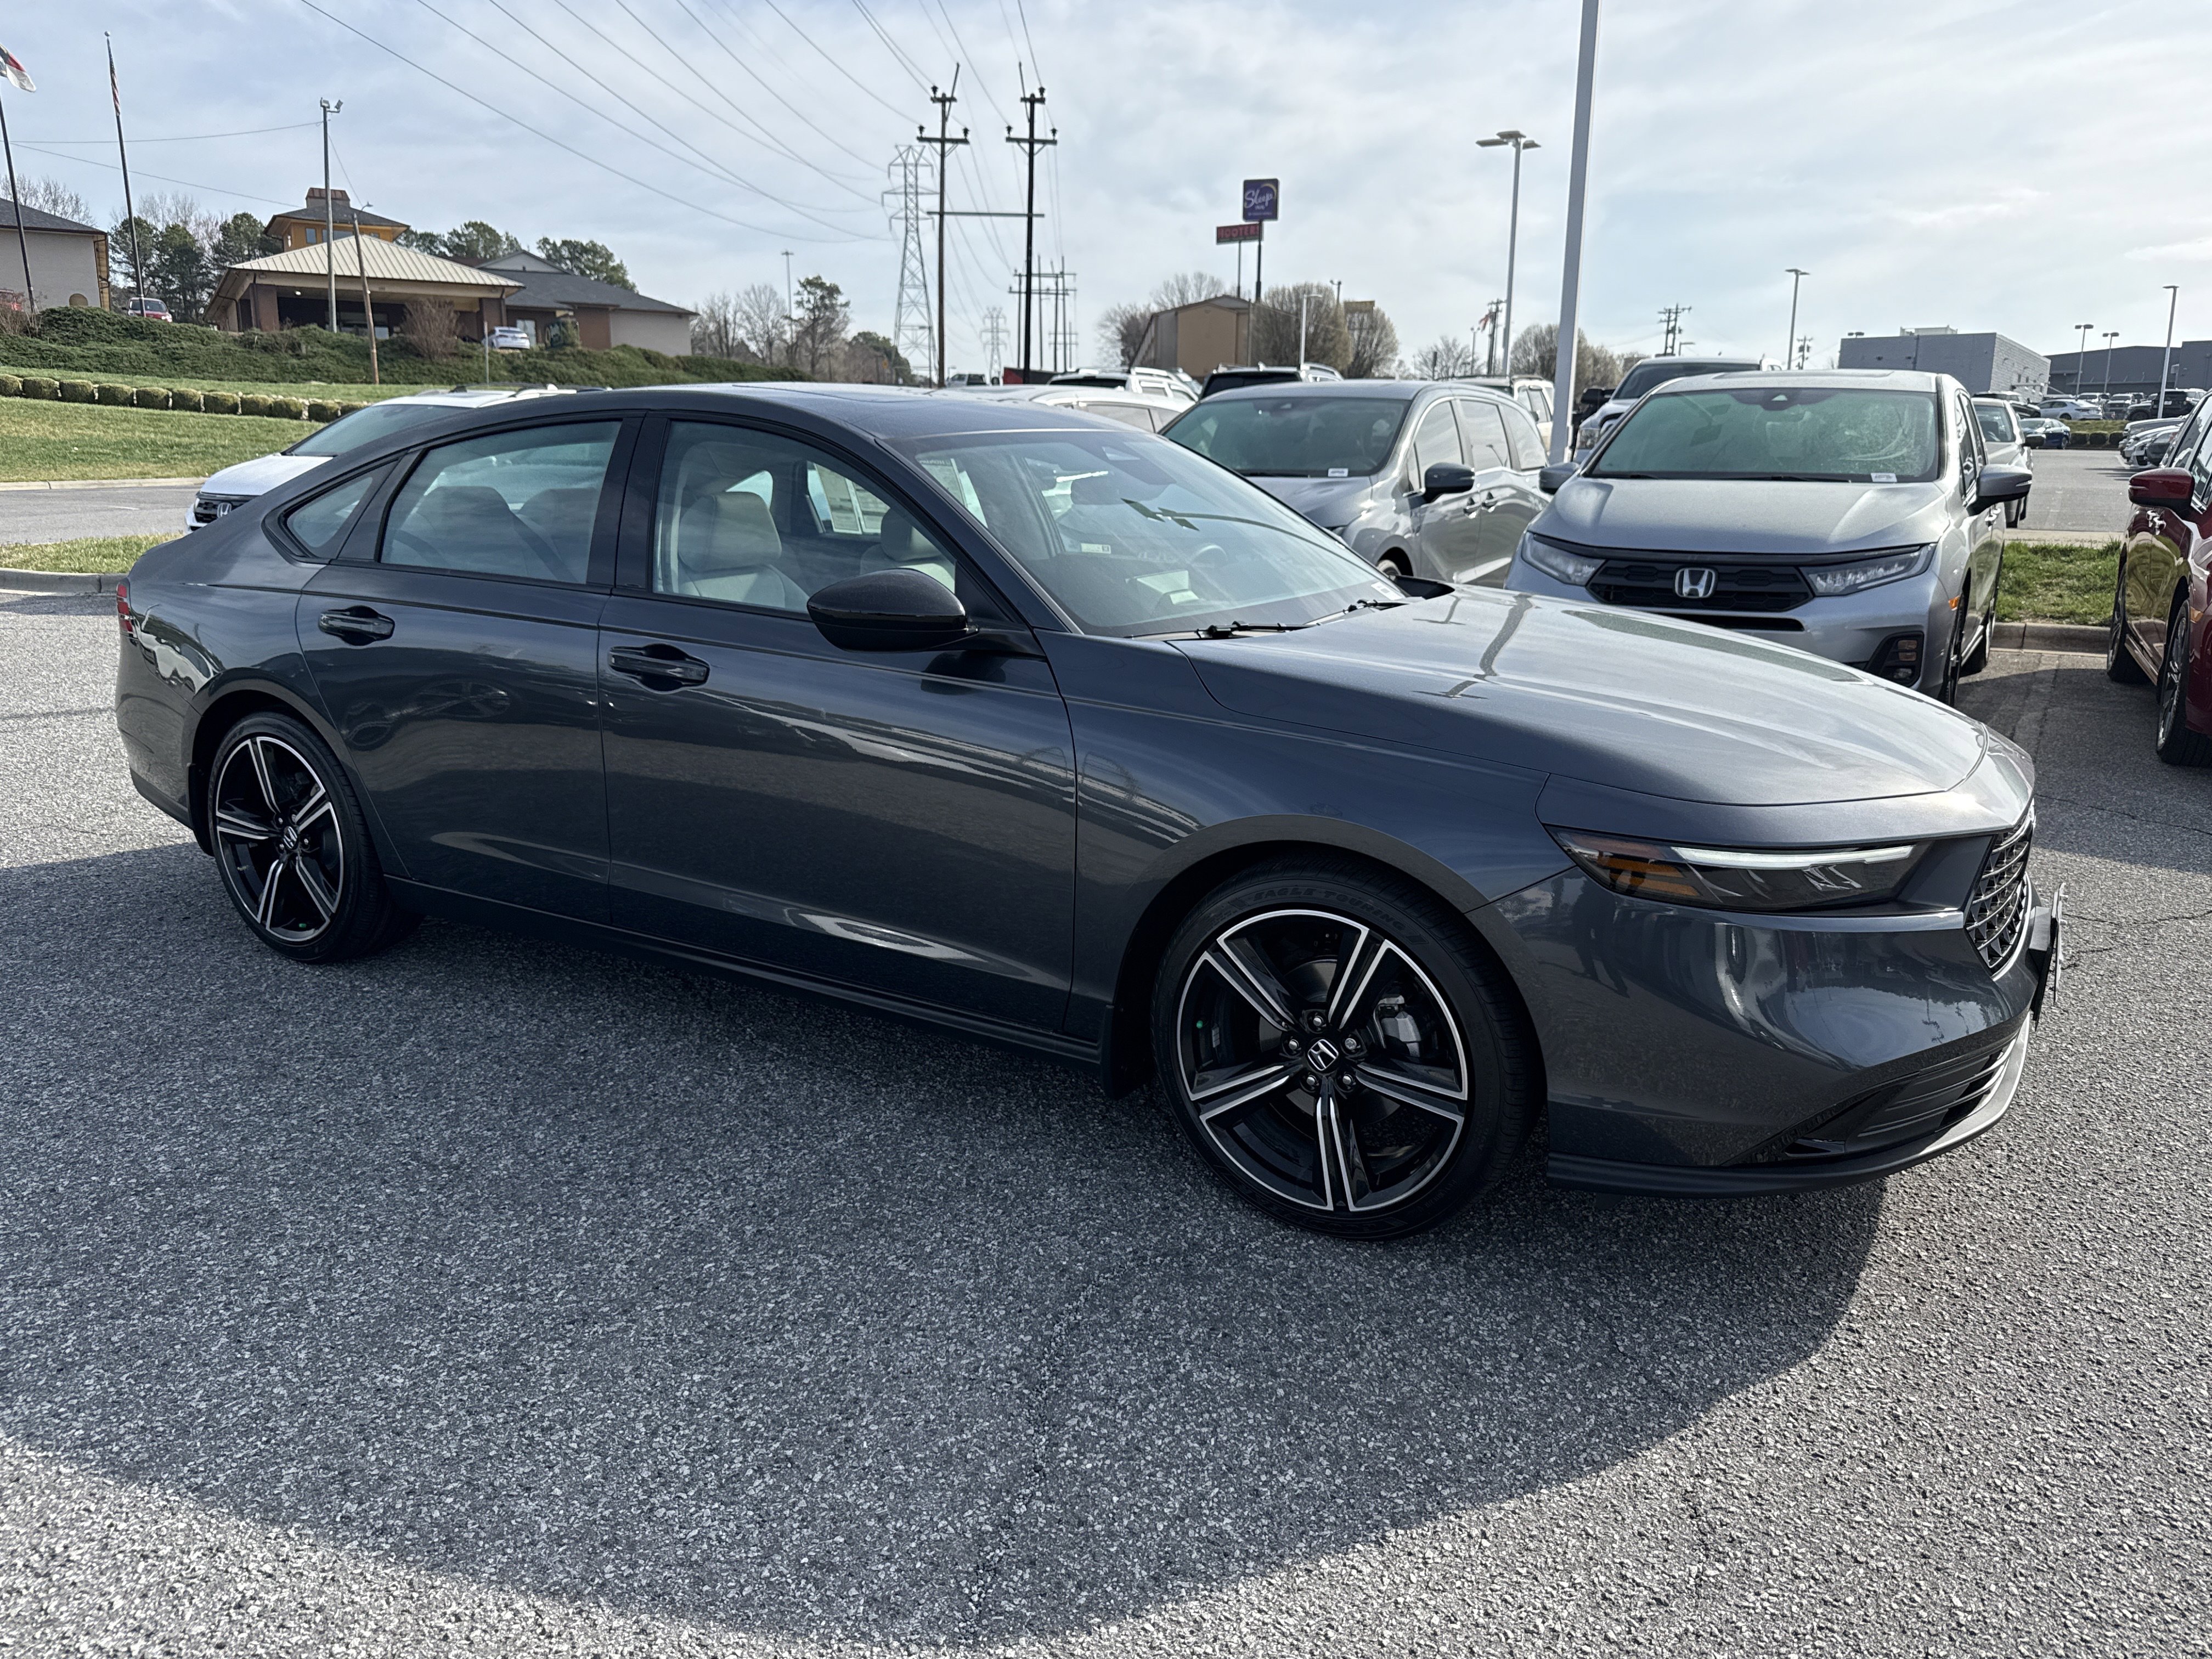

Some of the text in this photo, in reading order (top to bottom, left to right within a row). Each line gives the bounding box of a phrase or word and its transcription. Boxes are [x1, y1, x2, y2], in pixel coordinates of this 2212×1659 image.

[1245, 189, 1273, 208] Sleep
[1254, 888, 1405, 930] EAGLE TOURING
